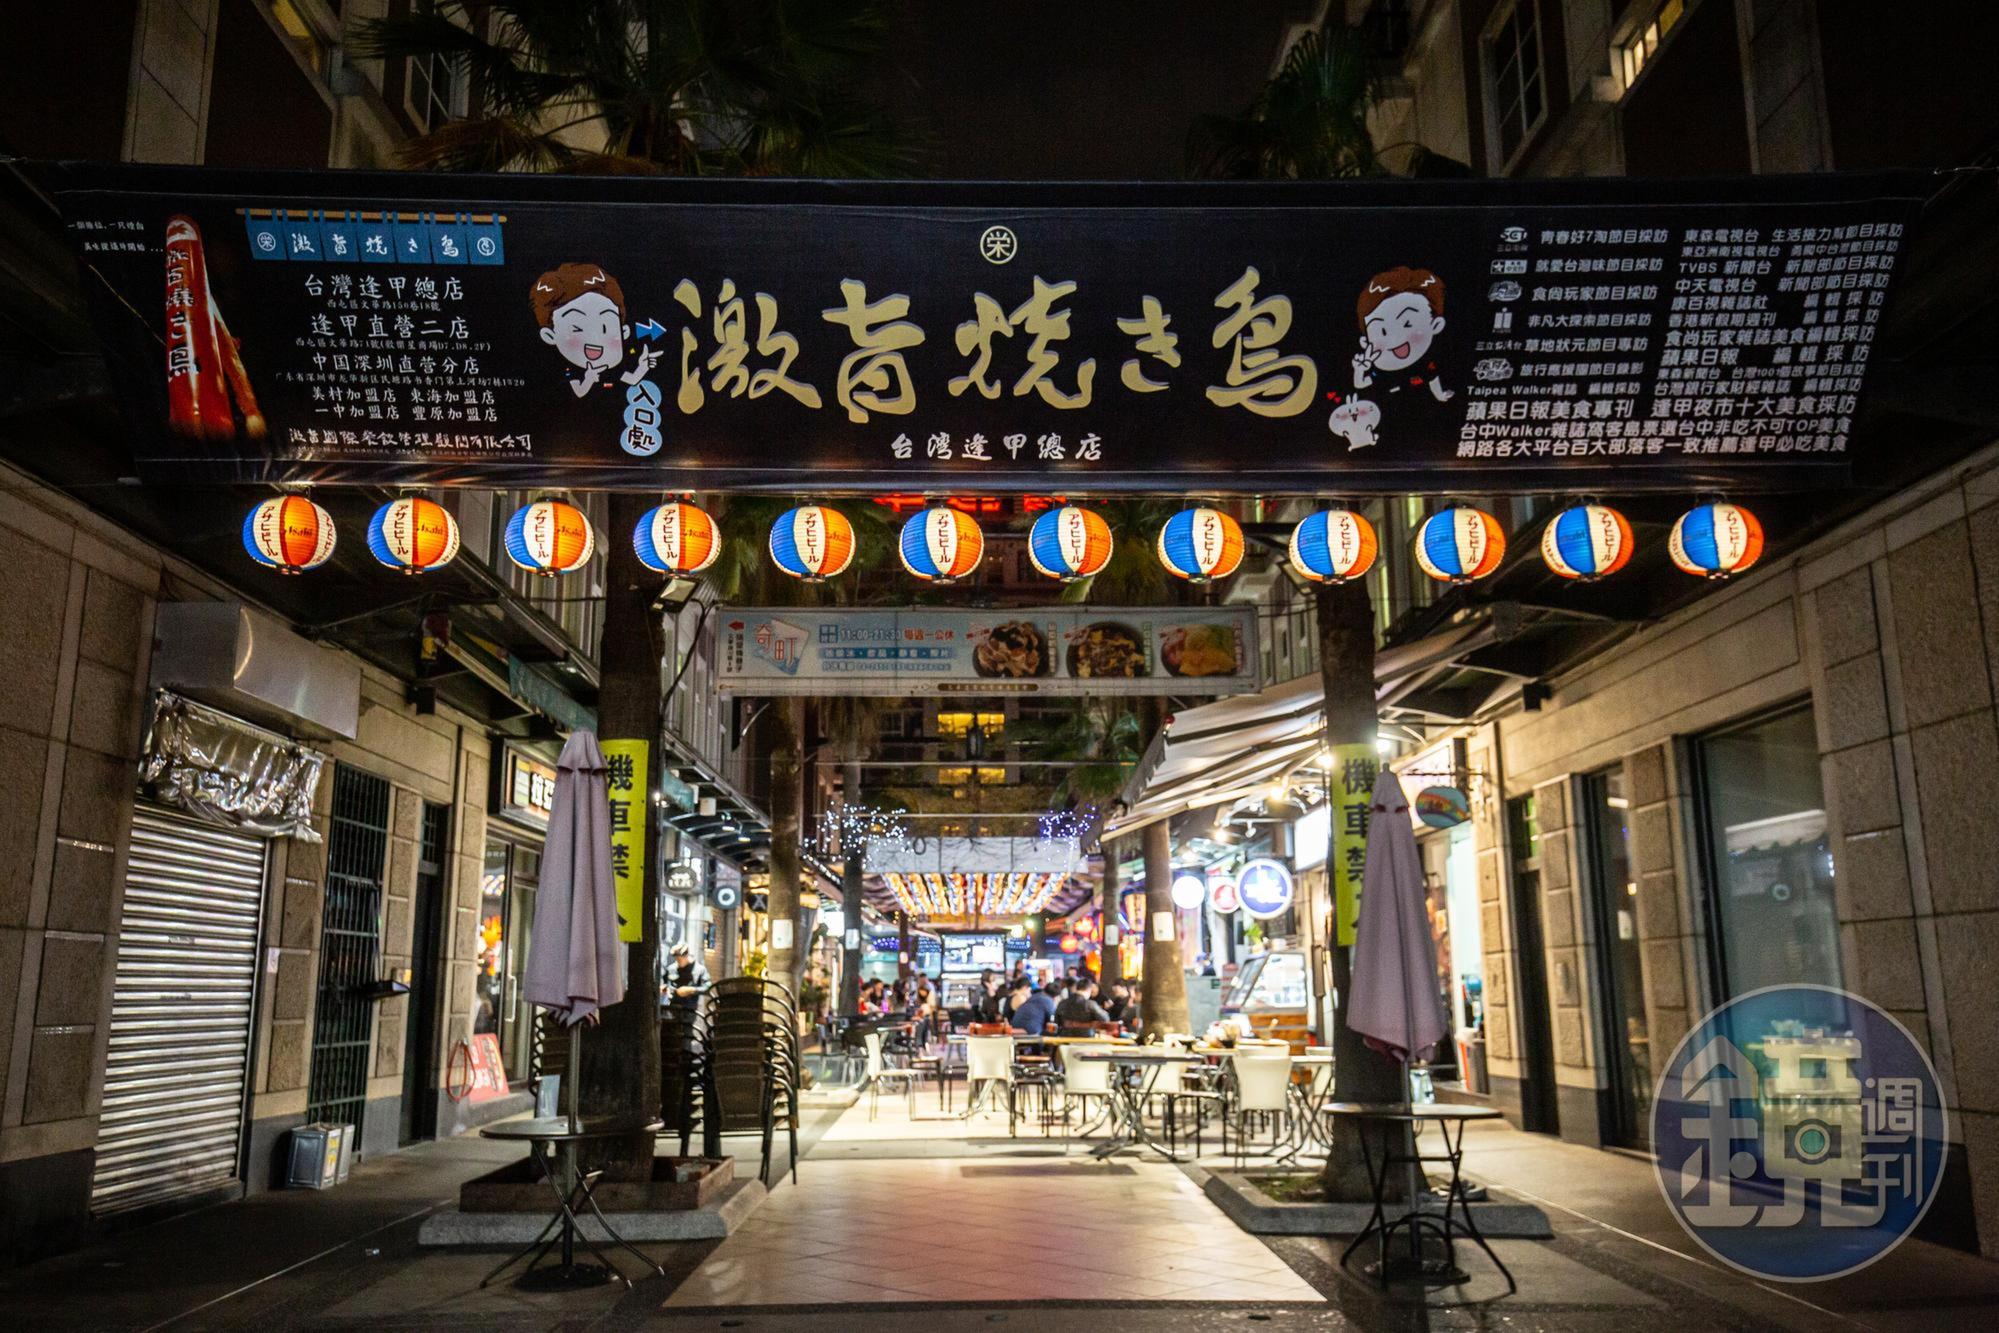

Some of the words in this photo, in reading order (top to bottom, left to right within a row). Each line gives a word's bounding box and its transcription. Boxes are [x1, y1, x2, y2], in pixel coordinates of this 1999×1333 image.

[1679, 262, 1718, 274] TVBS
[1723, 259, 1773, 275] 新聞台
[1784, 255, 1895, 274] 新聞部節目採訪
[304, 273, 465, 301] 台灣逢甲總店
[1531, 285, 1659, 301] 食尚玩家節目採訪
[1675, 277, 1757, 293] 中天電視台
[1777, 273, 1891, 292] 新聞部節目採訪
[311, 314, 471, 340] 逢甲直營二店
[312, 352, 480, 375] 中国深圳直营分店
[1660, 347, 1740, 366] 蘋果日報
[312, 386, 397, 404] 美村加盟店
[410, 387, 496, 406] 東海加盟店
[1650, 395, 1857, 418] 逢甲夜市十大美食採訪
[314, 404, 400, 421] 一中加盟店
[412, 405, 498, 423] 豐原加盟店
[627, 381, 657, 451] 入口處
[1465, 398, 1635, 420] 蘋果日報美食專刊
[891, 430, 1102, 462] 台灣逢甲總店
[261, 505, 279, 557] アサヒビール
[394, 504, 409, 556] アサヒビール
[534, 509, 549, 559] アサヒビール
[663, 508, 678, 559] アサヒビール
